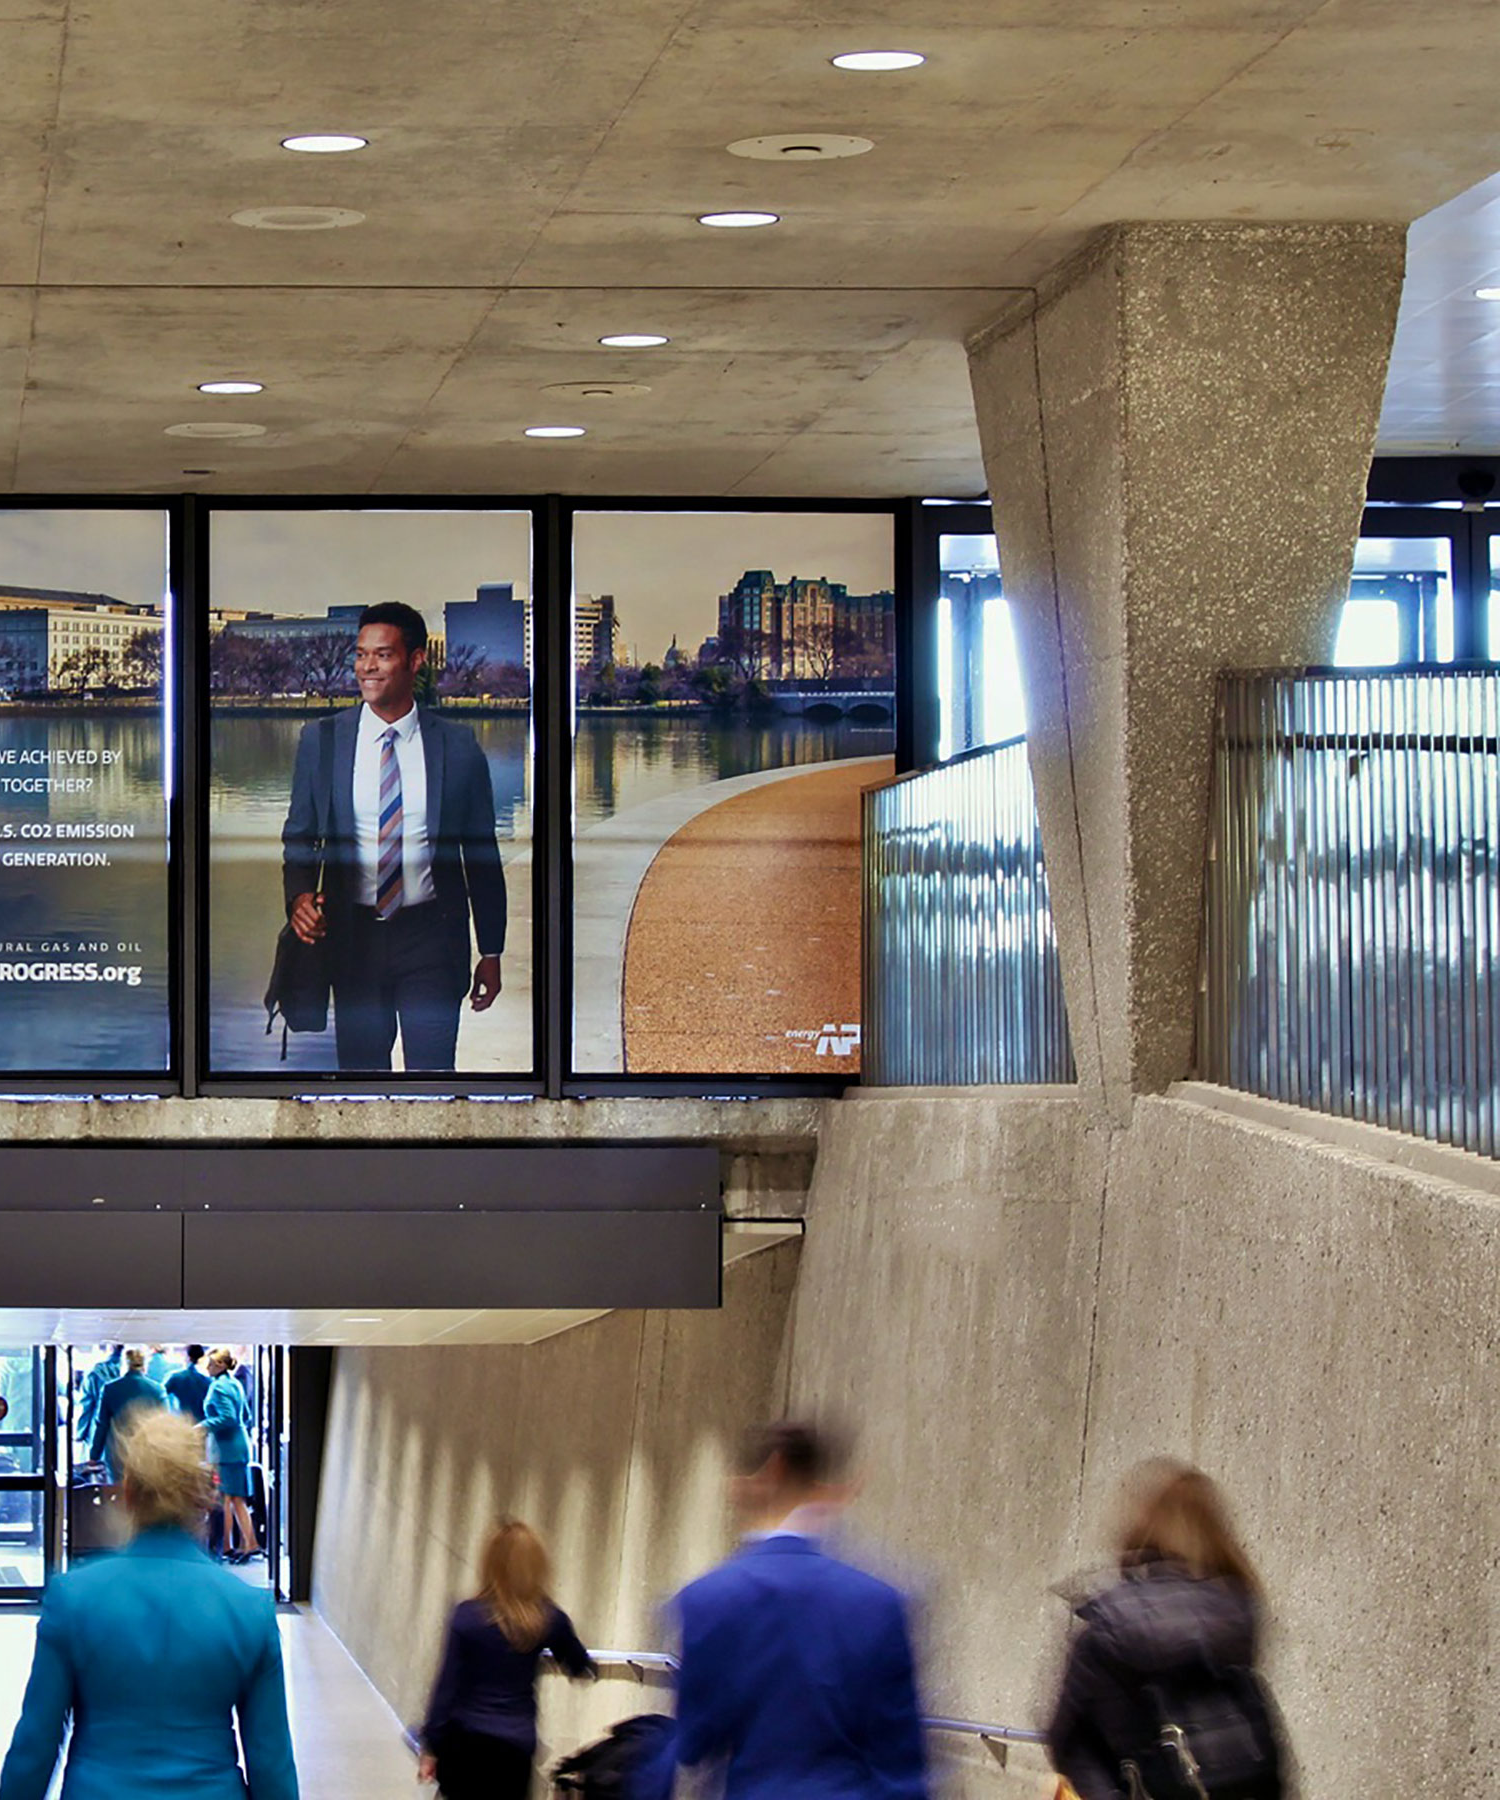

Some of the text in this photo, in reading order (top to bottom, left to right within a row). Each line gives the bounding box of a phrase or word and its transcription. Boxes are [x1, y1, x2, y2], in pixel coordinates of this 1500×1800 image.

[19, 750, 98, 764] ACHIEVED
[102, 750, 122, 764] BY
[1, 778, 93, 793] TOGETHER?
[21, 824, 52, 838] CO2
[56, 824, 135, 838] EMISSION
[2, 853, 111, 867] GENERATION.
[41, 942, 71, 953] GAS
[77, 942, 109, 953] AND
[117, 942, 142, 953] OIL
[785, 1029, 820, 1041] energy
